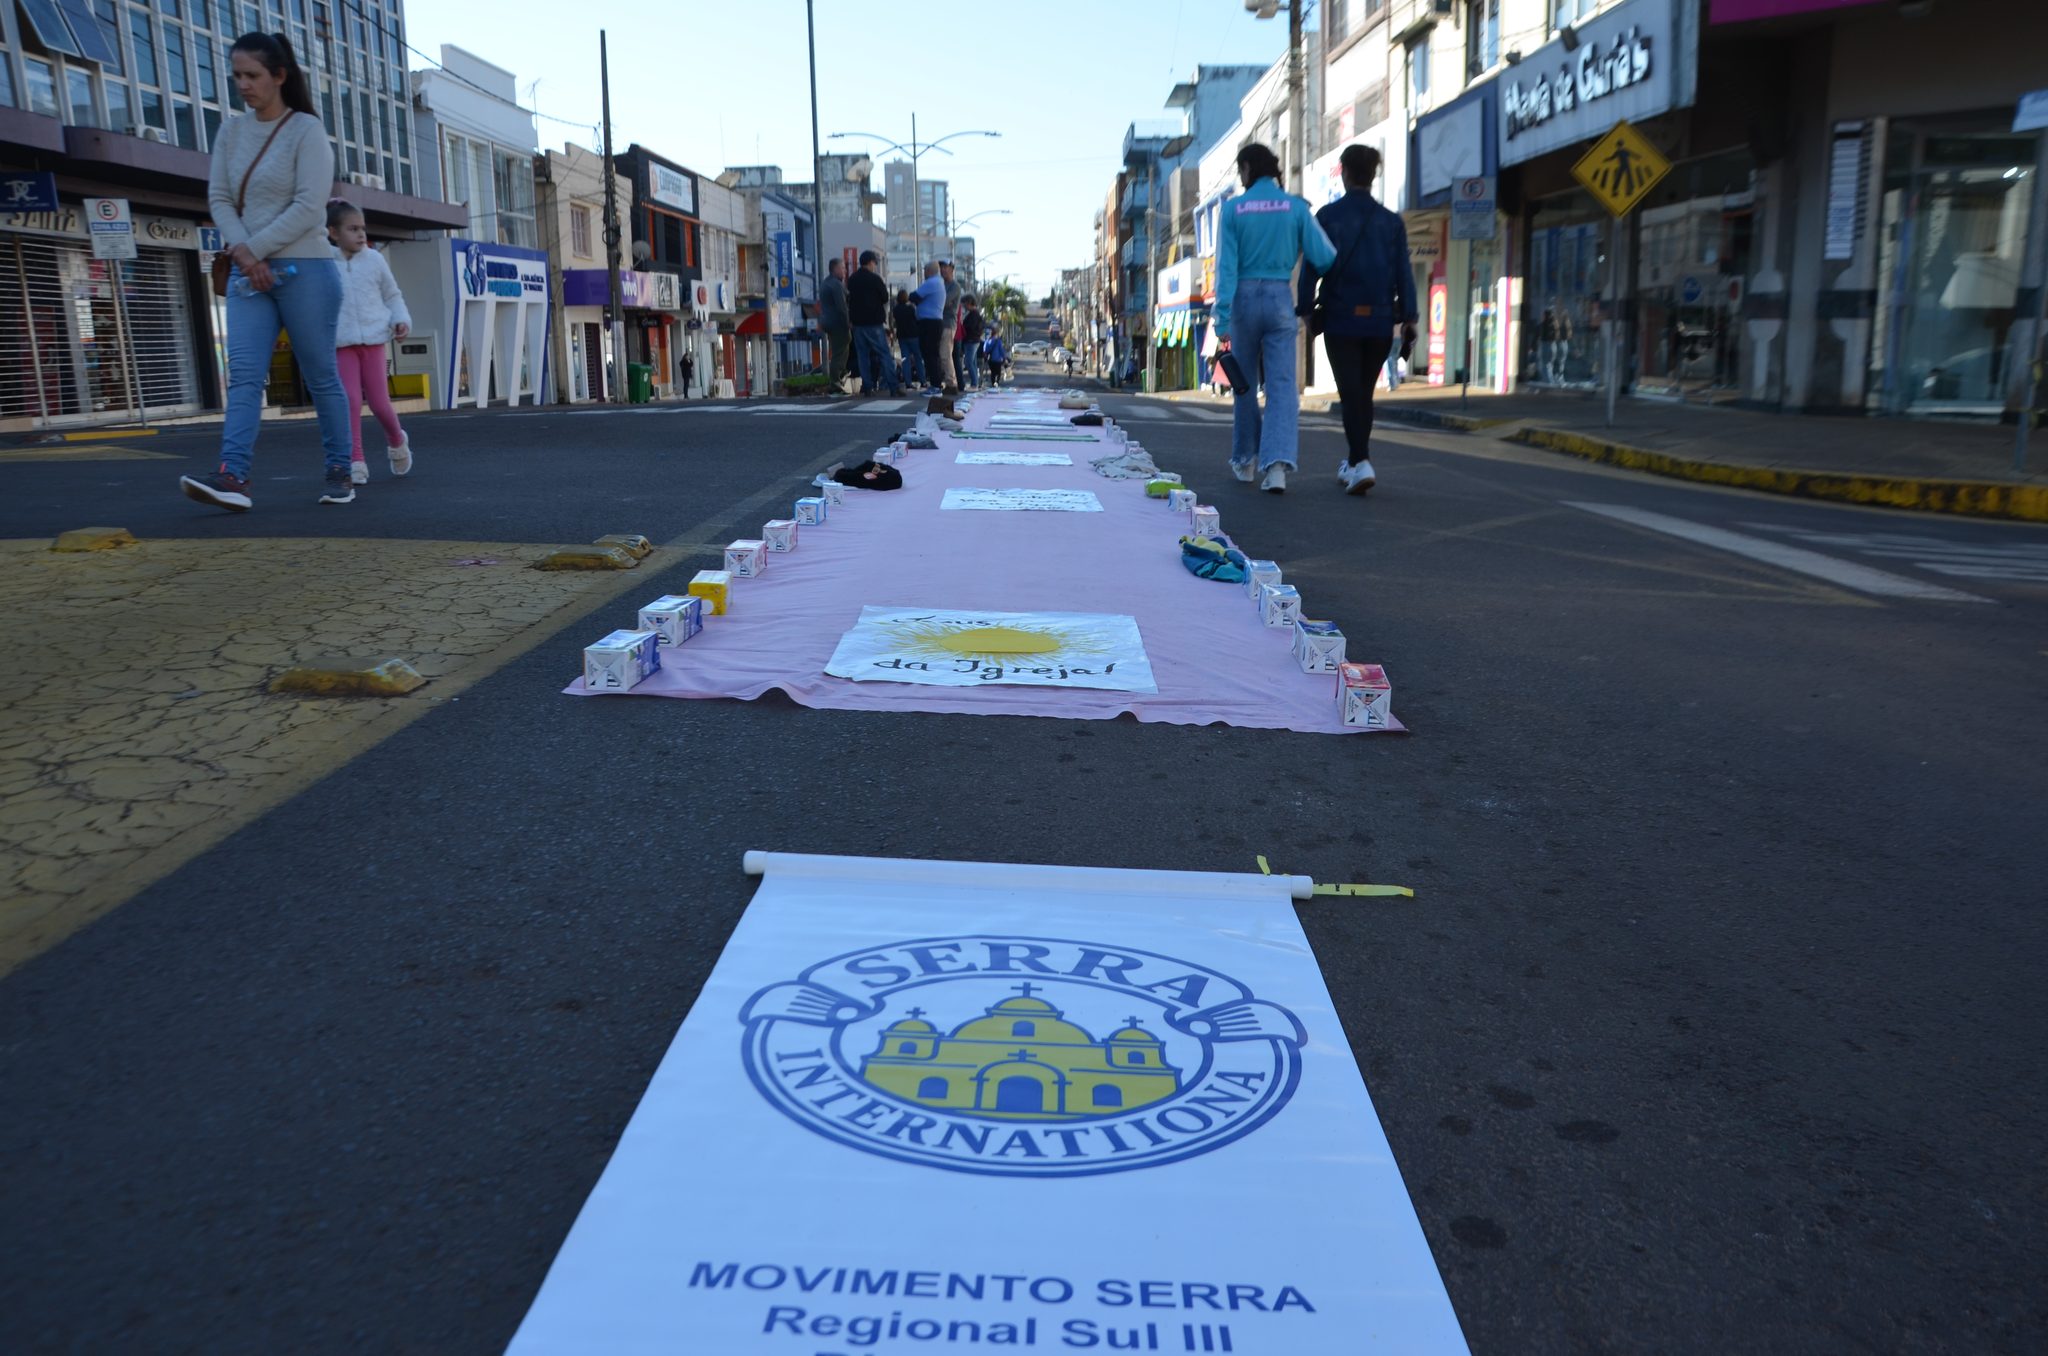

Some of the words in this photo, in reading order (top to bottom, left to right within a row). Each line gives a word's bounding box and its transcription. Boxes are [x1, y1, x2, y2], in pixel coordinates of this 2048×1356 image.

[102, 204, 113, 217] E
[622, 279, 638, 297] vivo
[873, 658, 931, 673] da
[844, 941, 1209, 1009] SERRA
[687, 1261, 1075, 1304] MOVIMENTO
[1096, 1279, 1317, 1313] SERRA
[761, 1305, 1037, 1346] Regional
[1061, 1318, 1159, 1350] Sul
[1182, 1323, 1233, 1352] III
